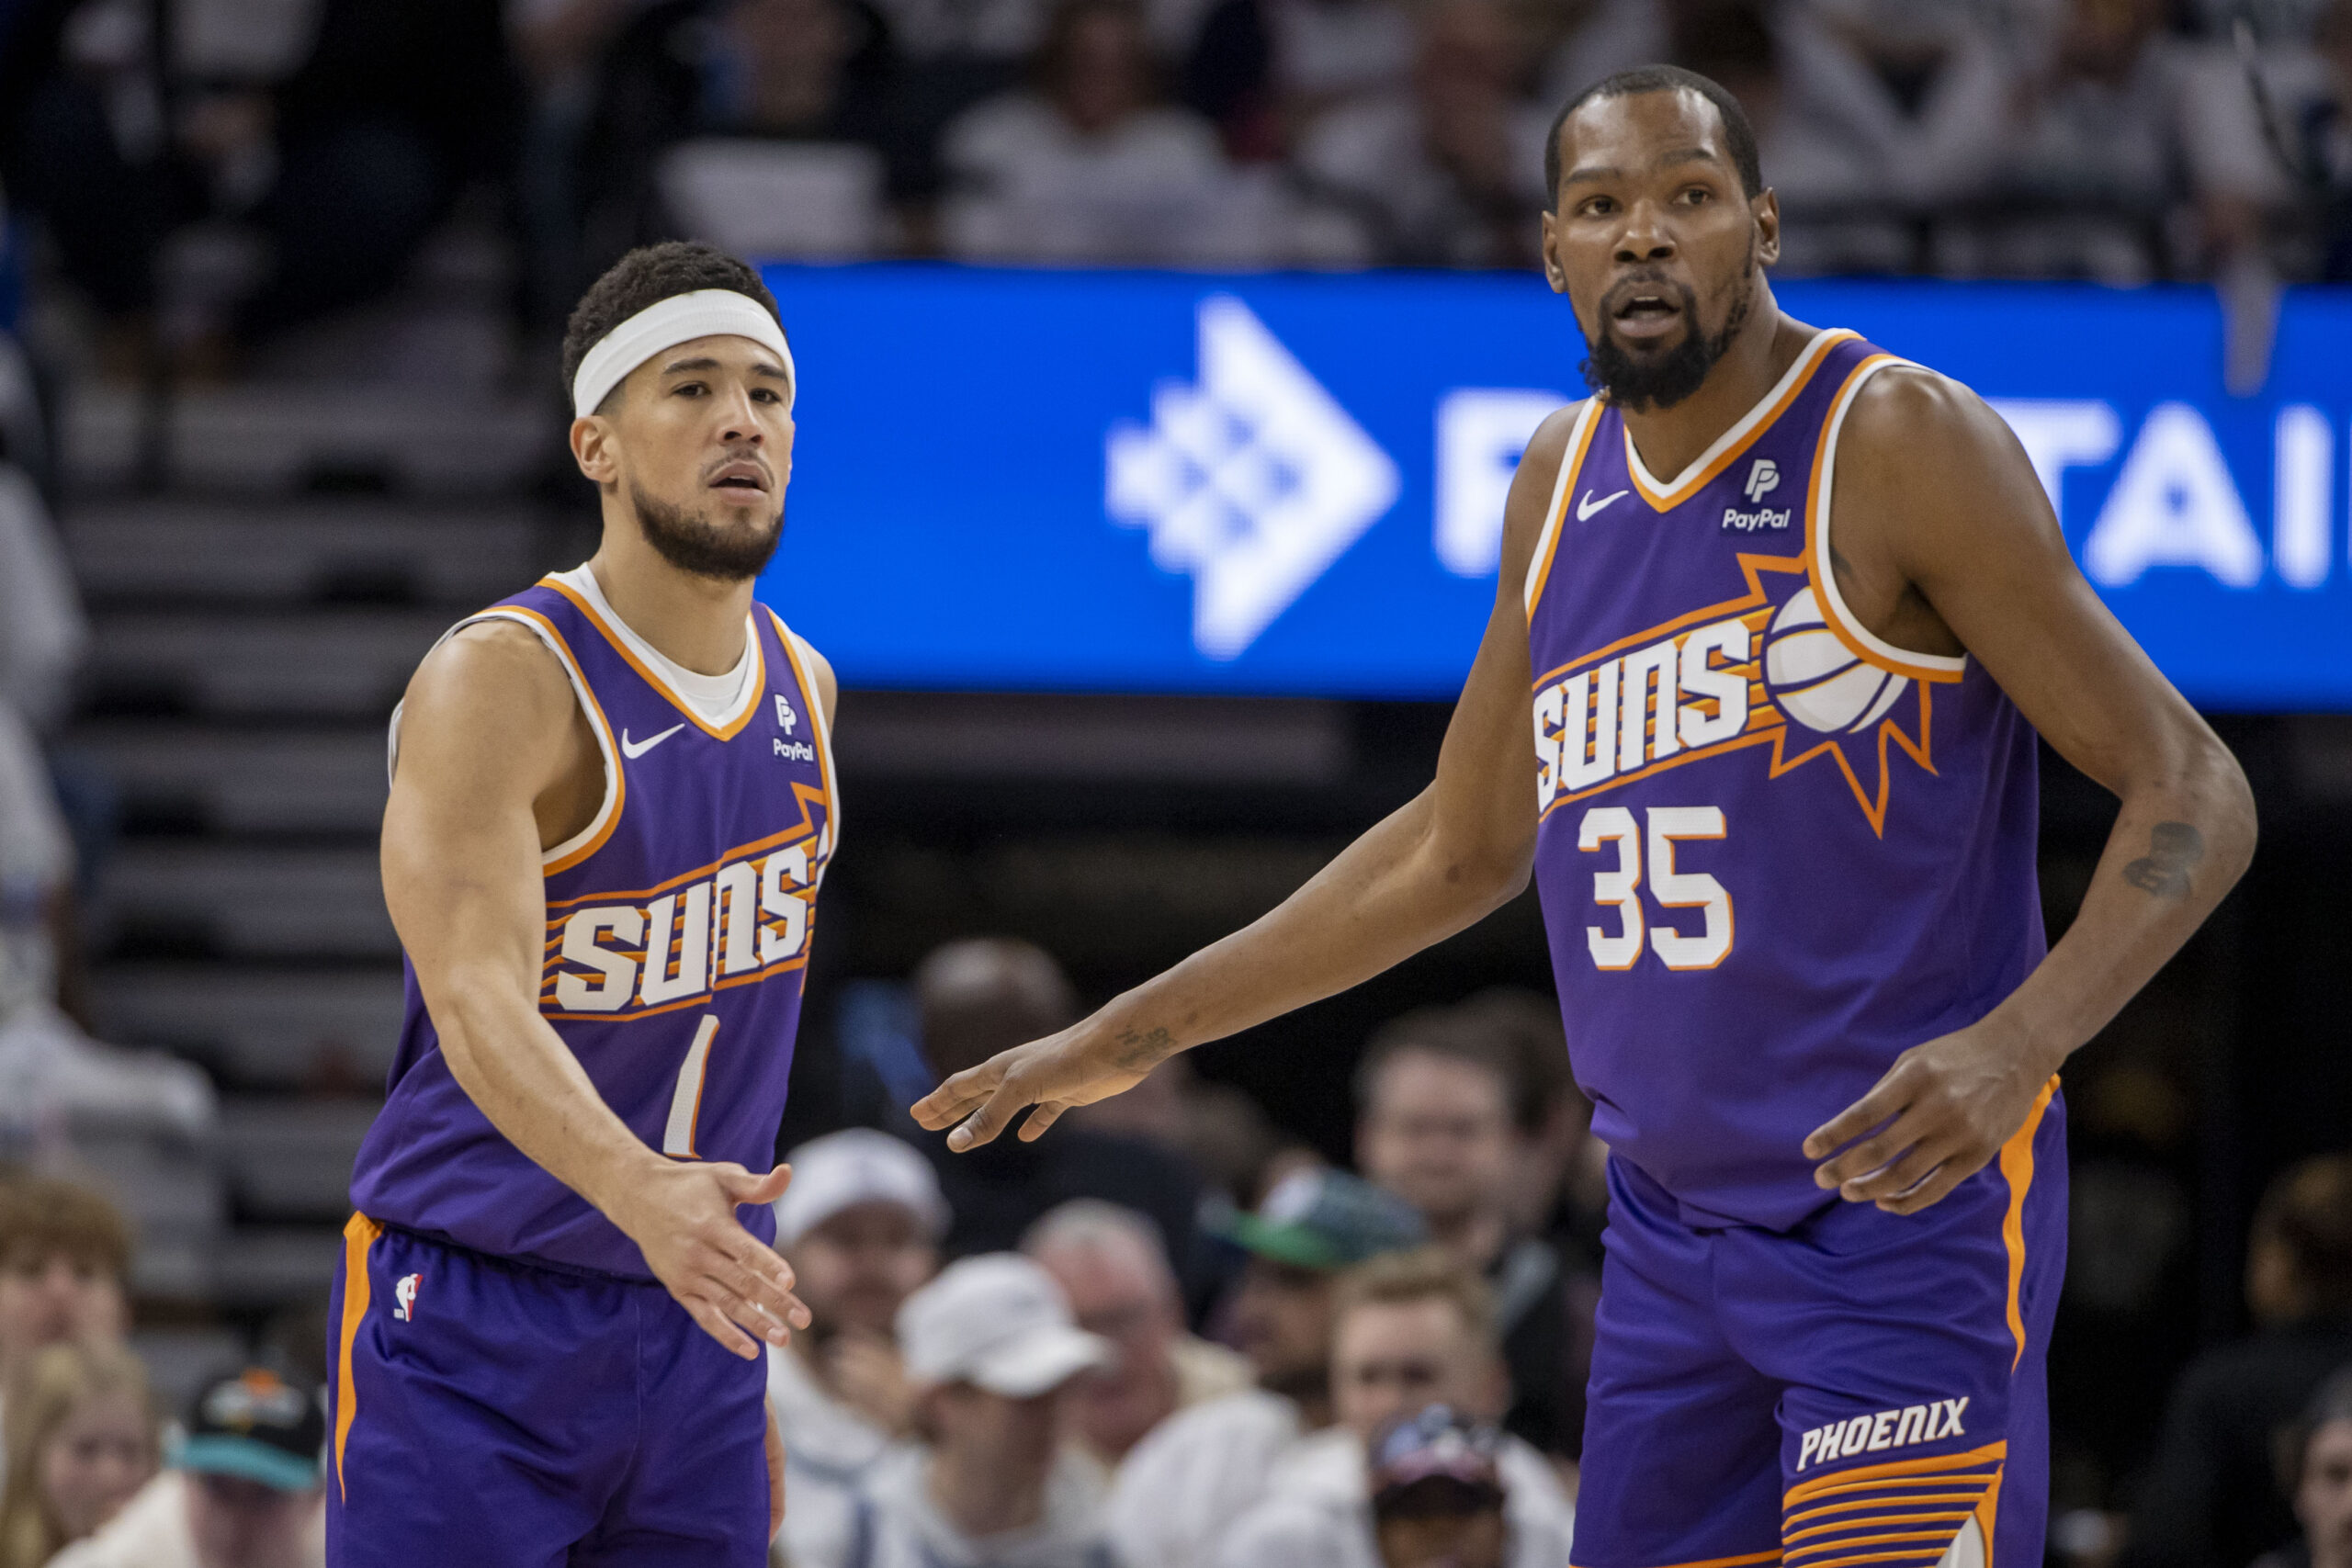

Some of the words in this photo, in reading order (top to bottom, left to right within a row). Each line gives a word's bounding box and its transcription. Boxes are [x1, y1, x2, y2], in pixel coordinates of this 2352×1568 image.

[1721, 508, 1792, 532] PayPal
[773, 738, 814, 761] PayPal
[1532, 618, 1750, 814] SUNS
[555, 845, 808, 1011] SUNS
[1577, 805, 1735, 972] 35
[663, 1013, 720, 1159] 1
[1796, 1396, 1970, 1472] PHOENIX
